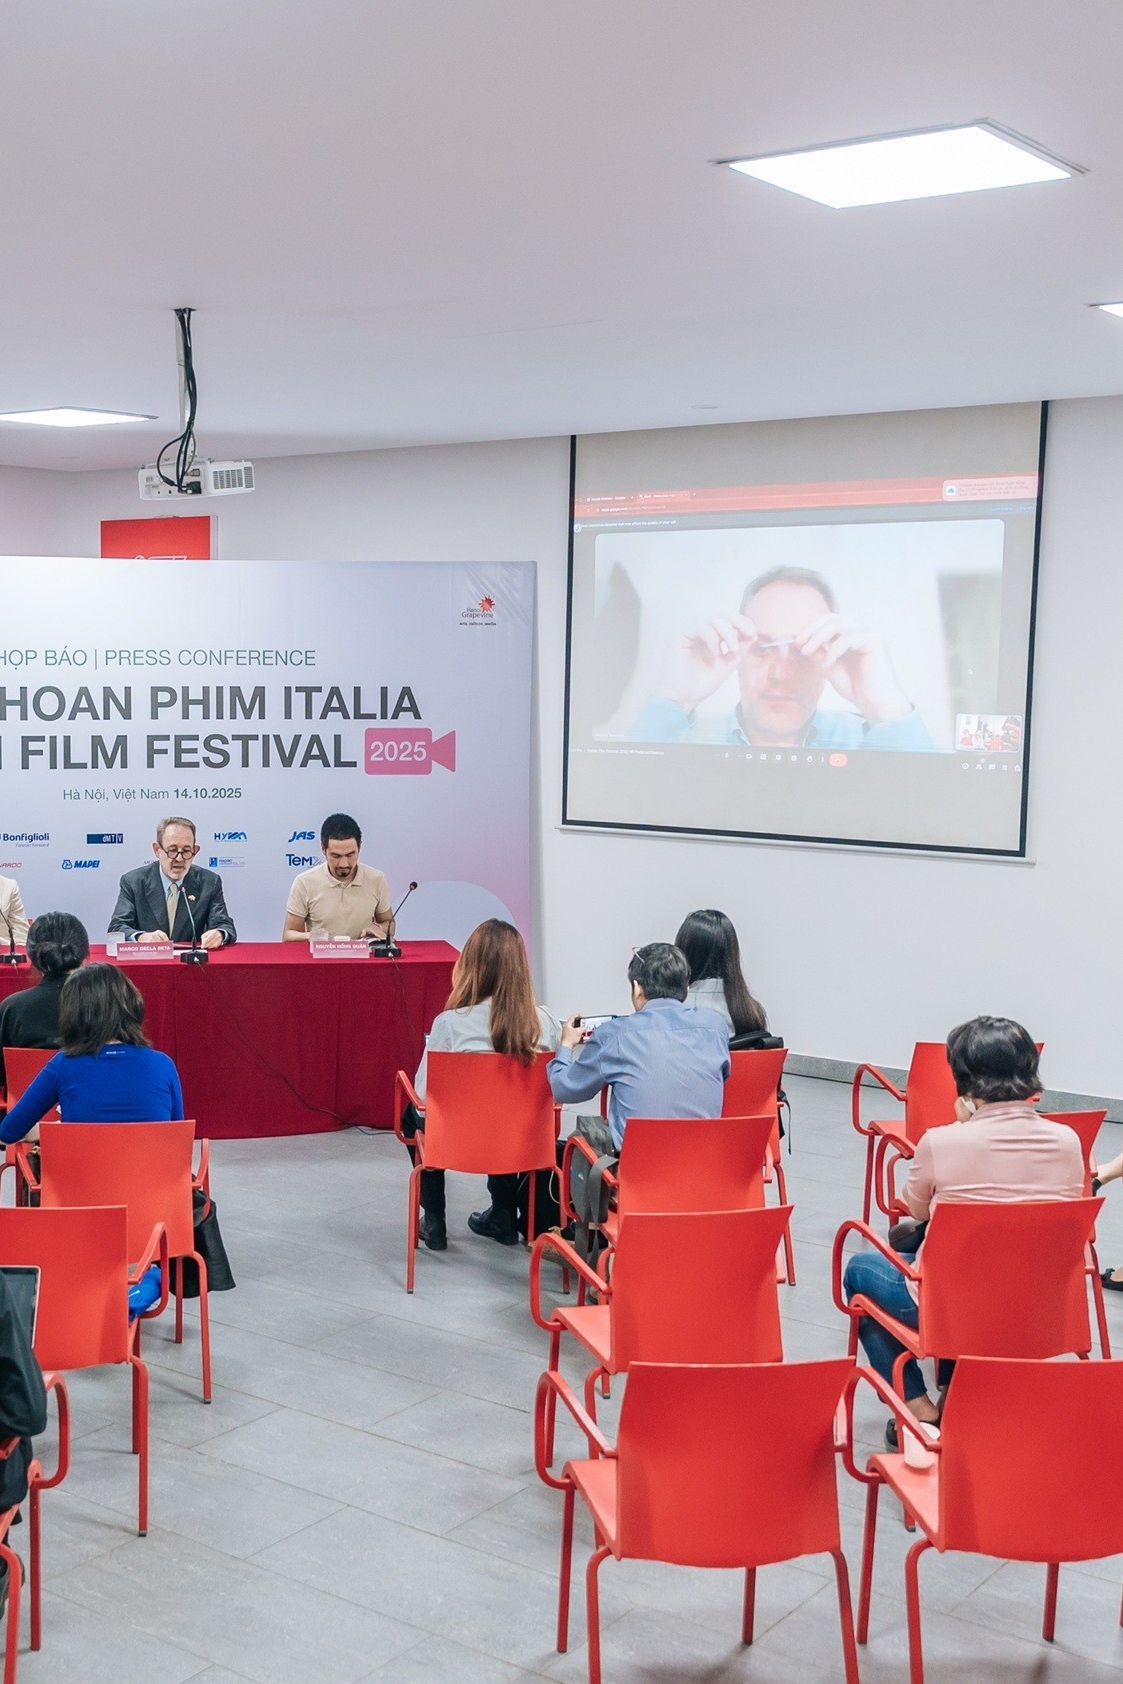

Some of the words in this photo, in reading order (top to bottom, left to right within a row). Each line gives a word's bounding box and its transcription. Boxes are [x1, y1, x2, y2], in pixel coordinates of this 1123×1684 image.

[461, 611, 494, 619] Grapevine
[45, 646, 88, 666] BÁO
[105, 649, 172, 666] PRESS
[178, 649, 316, 666] CONFERENCE
[150, 685, 266, 720] PHIM
[284, 685, 422, 720] ITALIA
[21, 734, 128, 770] FILM
[146, 733, 357, 769] FESTIVAL
[370, 741, 427, 762] 2025
[63, 788, 81, 800] Hà
[85, 788, 109, 802] Nội,
[113, 788, 136, 802] Việt
[140, 789, 169, 800] Nam
[173, 787, 242, 799] 14.10.2025
[3, 832, 50, 843] Bonfiglioli
[287, 831, 316, 843] JAS
[73, 860, 101, 868] MAPEI
